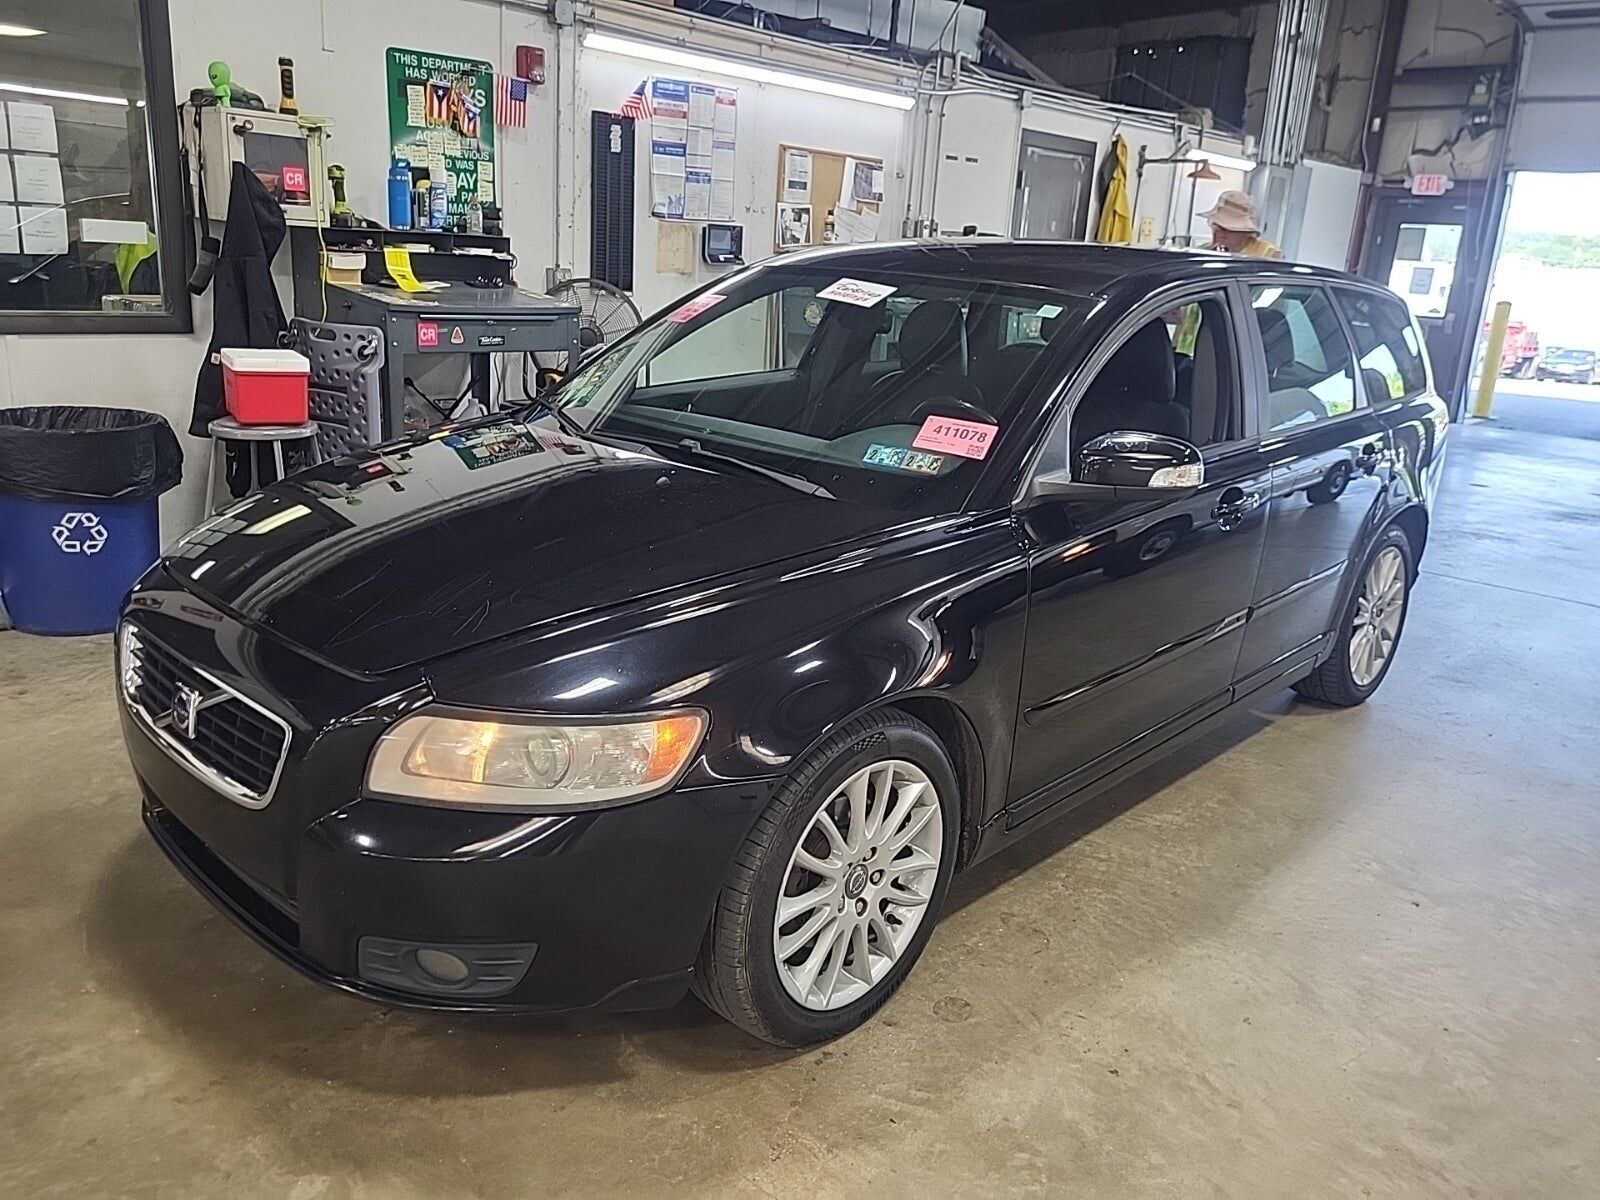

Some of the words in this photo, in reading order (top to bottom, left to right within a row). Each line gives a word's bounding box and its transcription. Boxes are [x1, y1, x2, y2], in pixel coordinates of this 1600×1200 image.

[394, 52, 418, 66] THIS
[421, 57, 486, 76] DEPARTMT
[405, 67, 428, 79] HAS
[455, 160, 475, 170] WAS
[286, 172, 303, 185] CR
[1418, 175, 1443, 193] EXIT
[420, 327, 436, 340] CR
[933, 424, 988, 443] 411078
[867, 449, 878, 460] 2
[906, 456, 915, 467] 2
